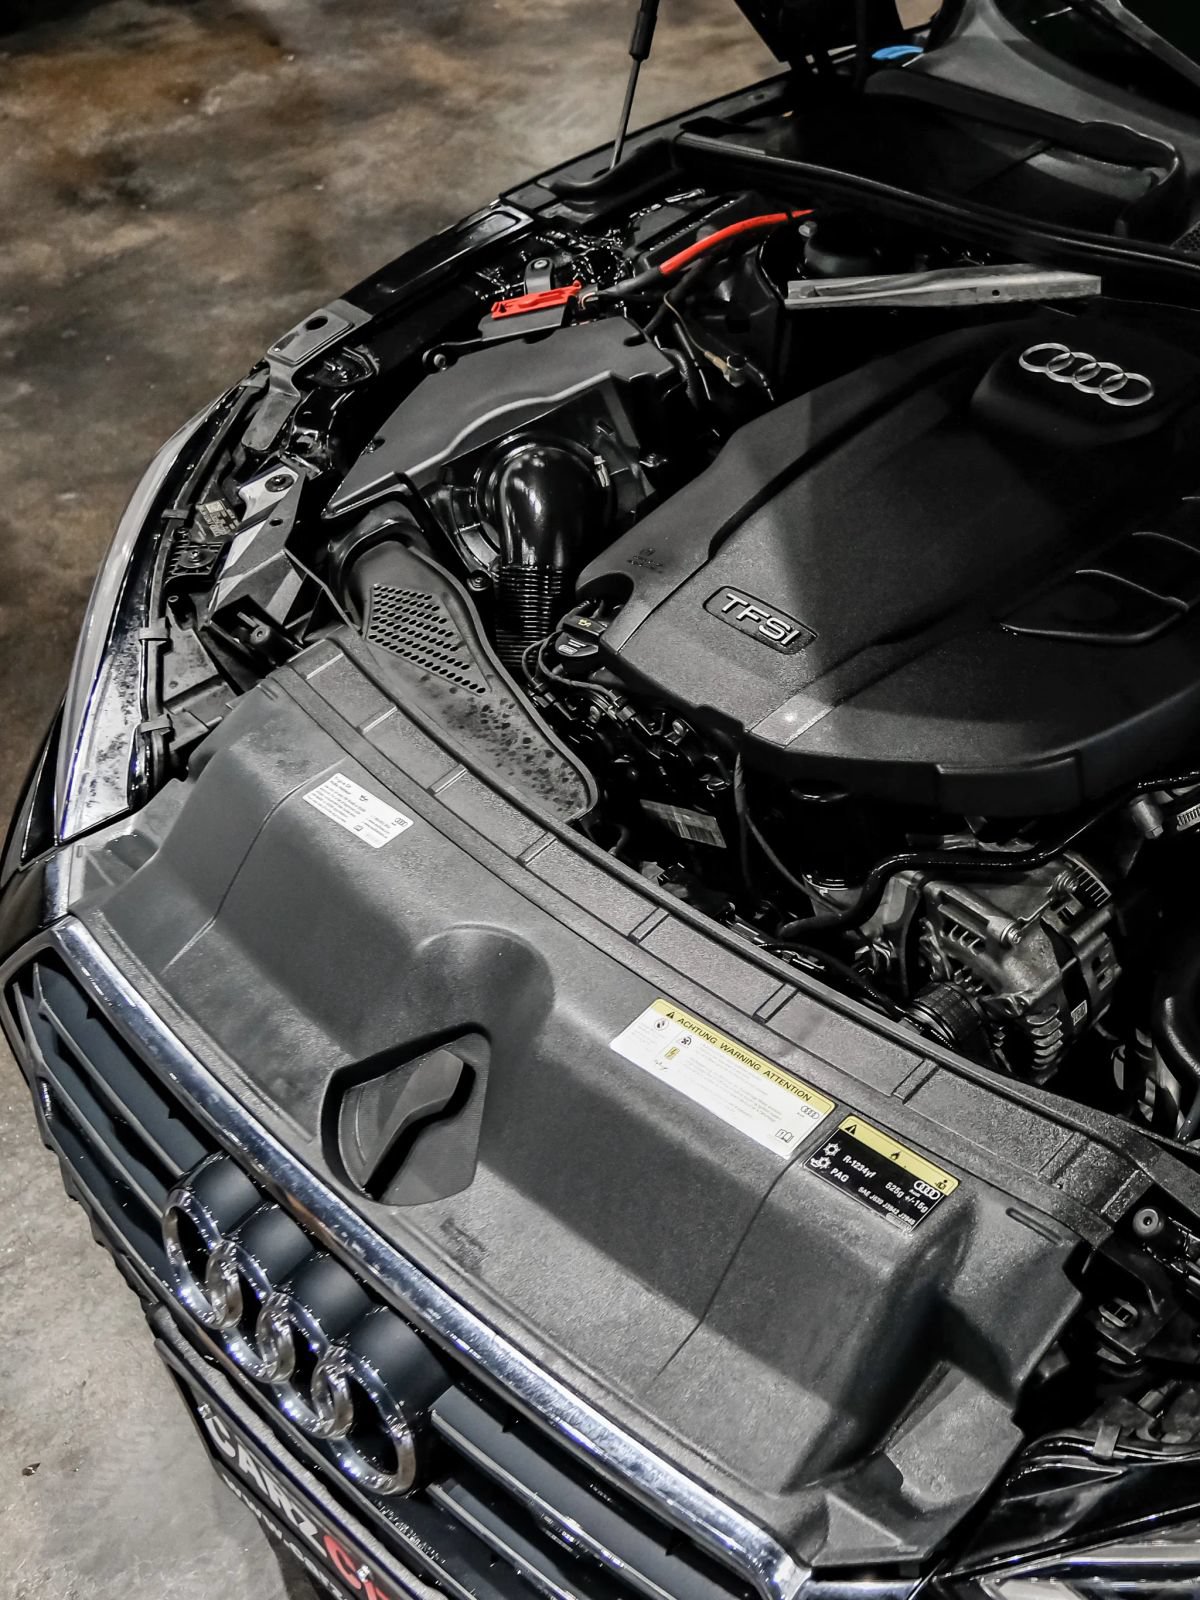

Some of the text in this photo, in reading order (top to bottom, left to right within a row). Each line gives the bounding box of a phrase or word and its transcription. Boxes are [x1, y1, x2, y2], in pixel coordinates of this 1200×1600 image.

[721, 592, 801, 646] TFSI
[677, 1017, 718, 1044] ACHTUNG
[719, 1042, 762, 1071] WARNING
[763, 1070, 812, 1102] ATTENTION
[830, 1167, 850, 1183] PAG
[842, 1154, 877, 1179] R-1234yf
